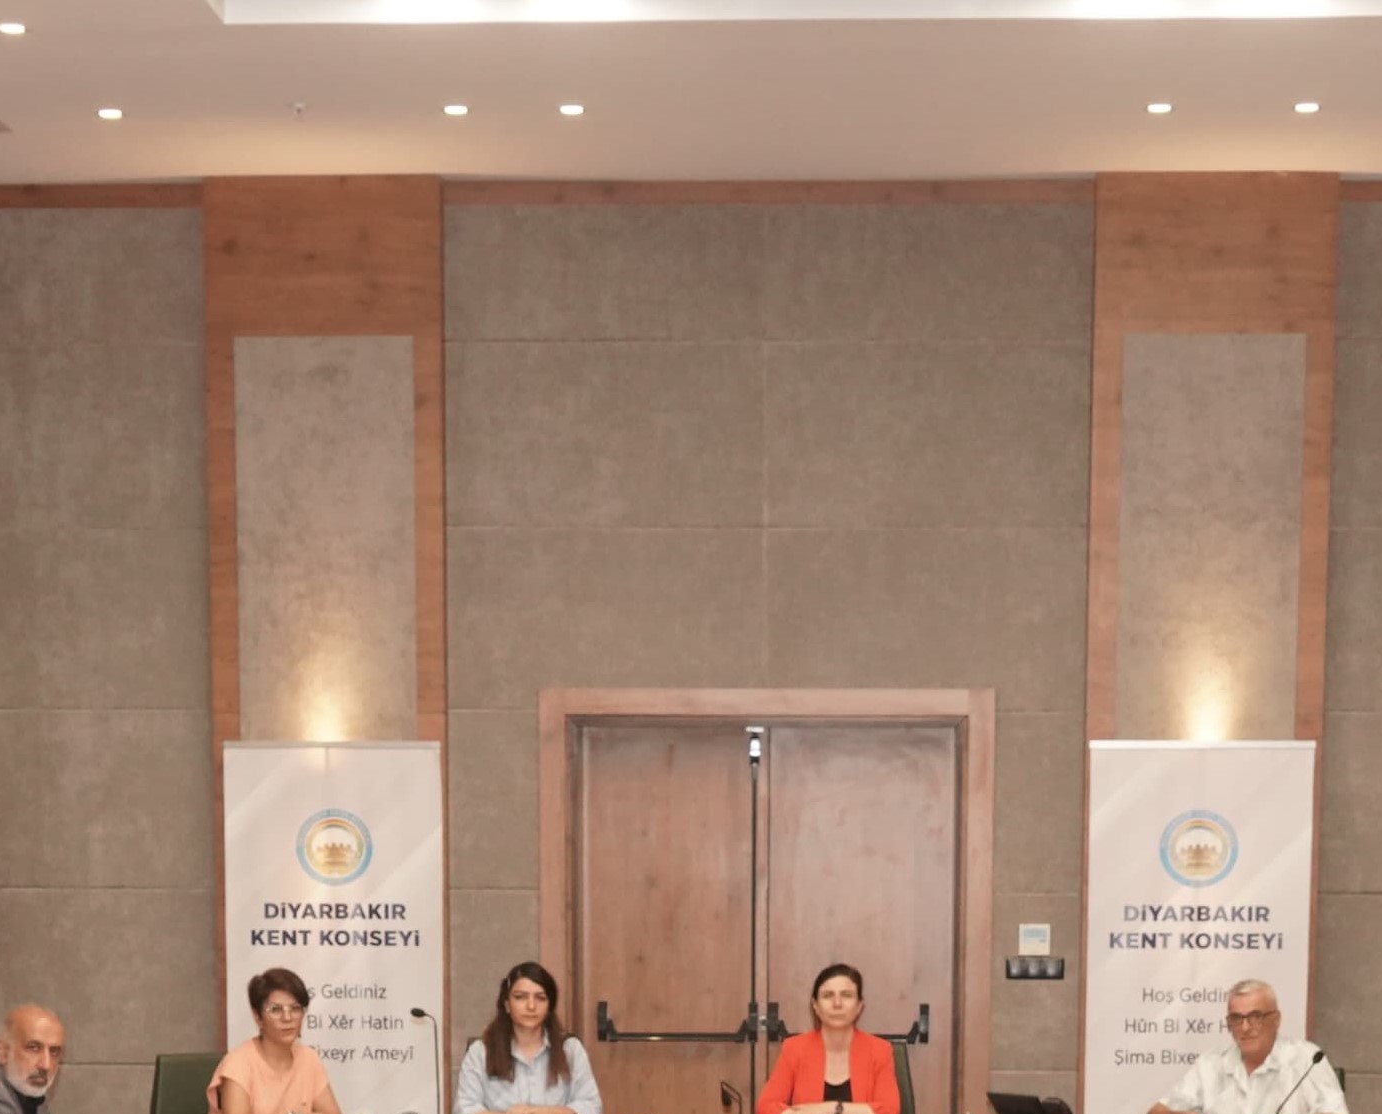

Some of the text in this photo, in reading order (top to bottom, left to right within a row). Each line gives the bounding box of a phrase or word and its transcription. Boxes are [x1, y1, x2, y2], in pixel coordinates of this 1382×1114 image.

[251, 930, 311, 946] KENT
[1109, 932, 1172, 949] KENT
[321, 984, 387, 999] Geldiniz
[1142, 987, 1174, 1004] Hoş
[307, 1014, 404, 1030] Bi Xêr Hatin
[1125, 1018, 1158, 1033] Hûn
[1164, 1018, 1179, 1033] Bi
[1186, 1017, 1213, 1034] Xêr
[309, 1045, 355, 1063] ixeyr
[1114, 1049, 1200, 1066] Şima Bixe
